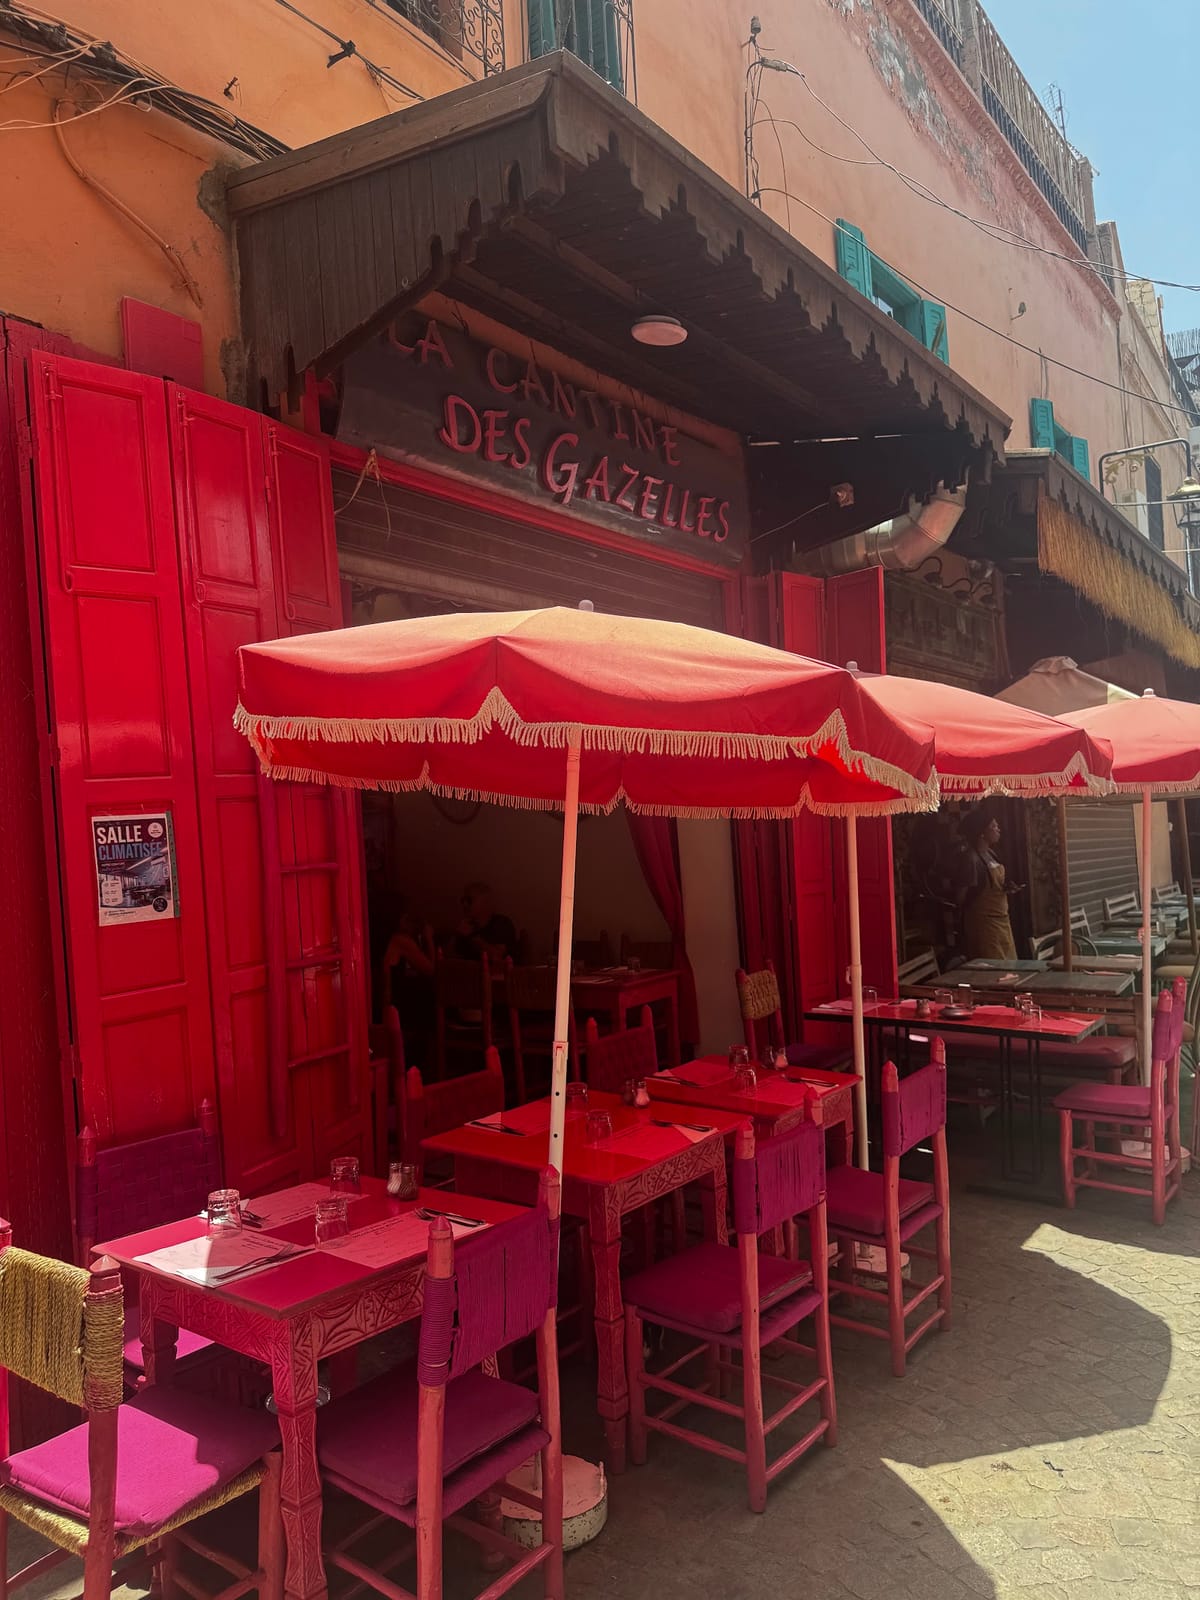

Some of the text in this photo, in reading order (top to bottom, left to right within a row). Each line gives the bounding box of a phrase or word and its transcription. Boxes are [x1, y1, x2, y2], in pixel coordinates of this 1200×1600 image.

[388, 319, 681, 465] LA CANTINE
[439, 394, 729, 543] DES GAZELLES
[96, 825, 143, 844] SALLE
